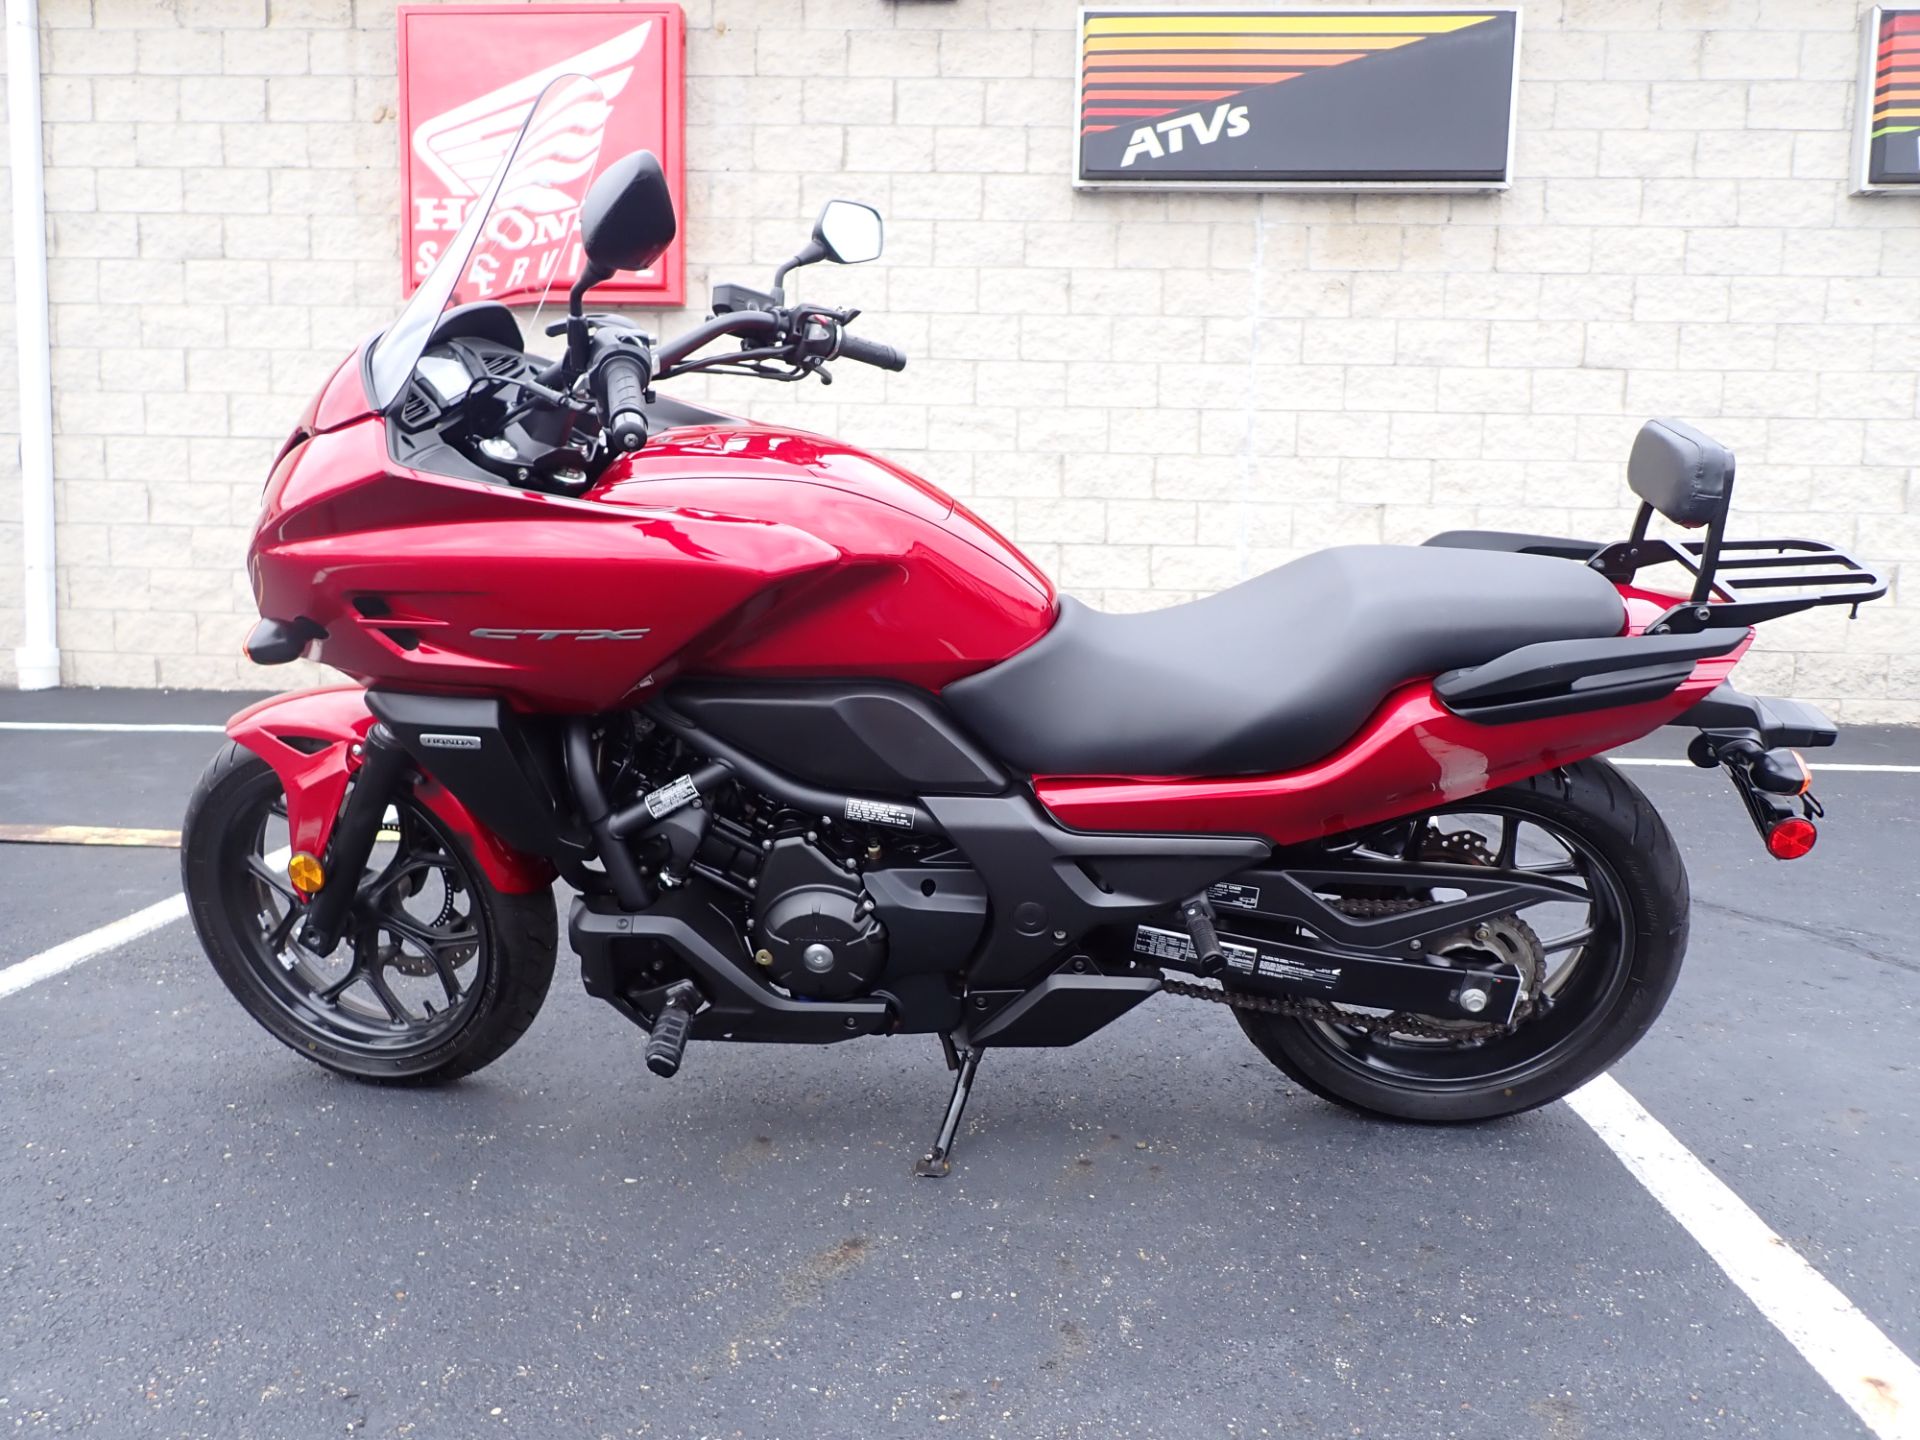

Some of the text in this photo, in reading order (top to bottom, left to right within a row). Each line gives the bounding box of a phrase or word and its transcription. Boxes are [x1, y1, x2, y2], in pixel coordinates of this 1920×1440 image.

[1120, 103, 1250, 168] ATVs
[414, 197, 584, 250] HON
[414, 241, 655, 296] SERVI
[470, 627, 651, 641] CTX
